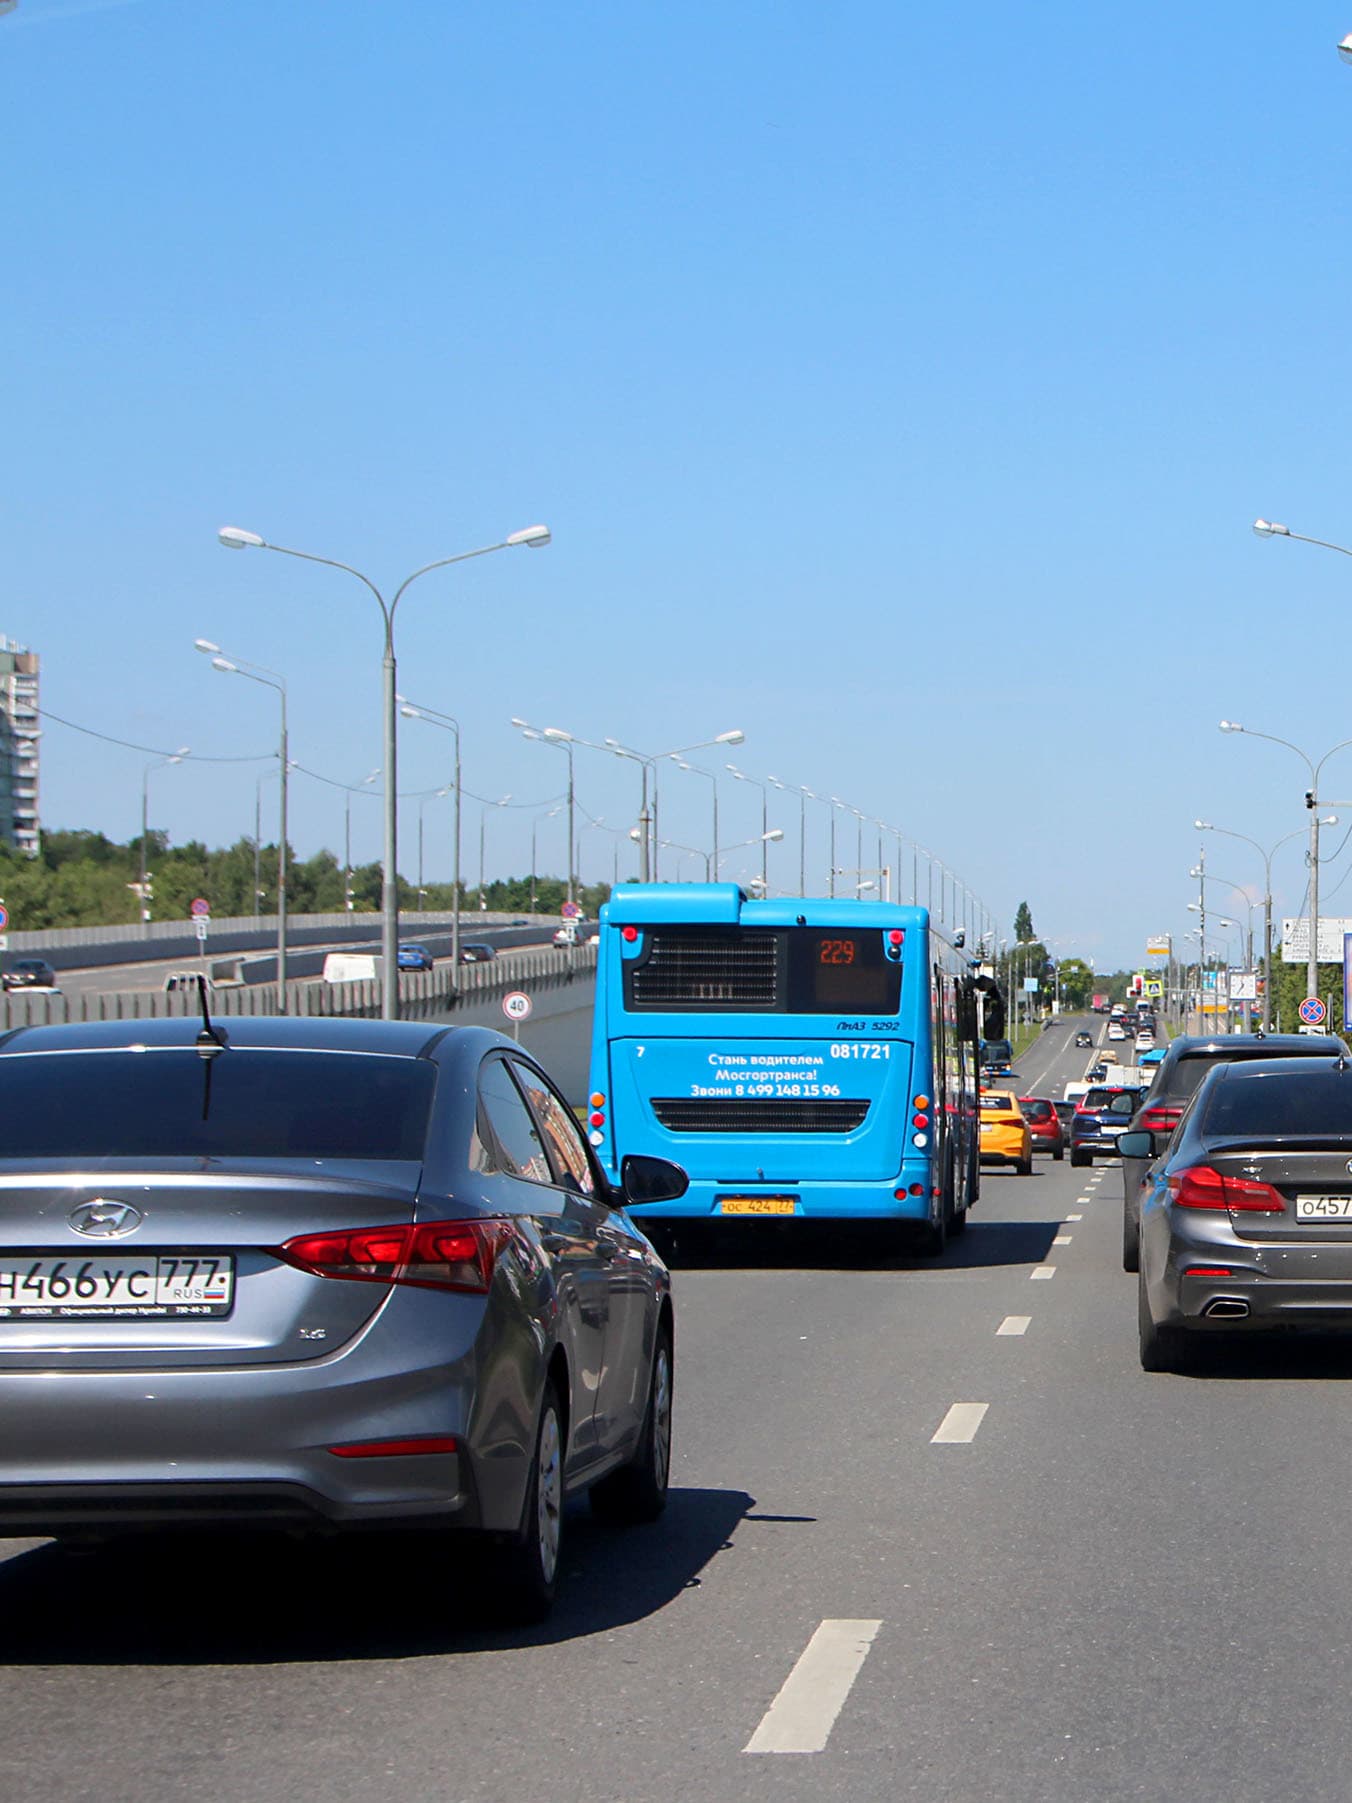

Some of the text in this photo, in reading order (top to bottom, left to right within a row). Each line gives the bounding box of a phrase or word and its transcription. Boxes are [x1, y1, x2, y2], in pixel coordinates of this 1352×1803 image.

[820, 940, 854, 964] 229
[510, 1000, 524, 1011] 40
[871, 1021, 900, 1031] 5292
[636, 1046, 645, 1058] 7
[830, 1044, 890, 1060] 081721
[708, 1053, 824, 1066] Стань водителем
[715, 1069, 818, 1083] Мосгортранса!
[690, 1084, 841, 1097] Звони 8 499 148 15 96
[161, 1259, 220, 1288] 777
[173, 1288, 202, 1299] RUS
